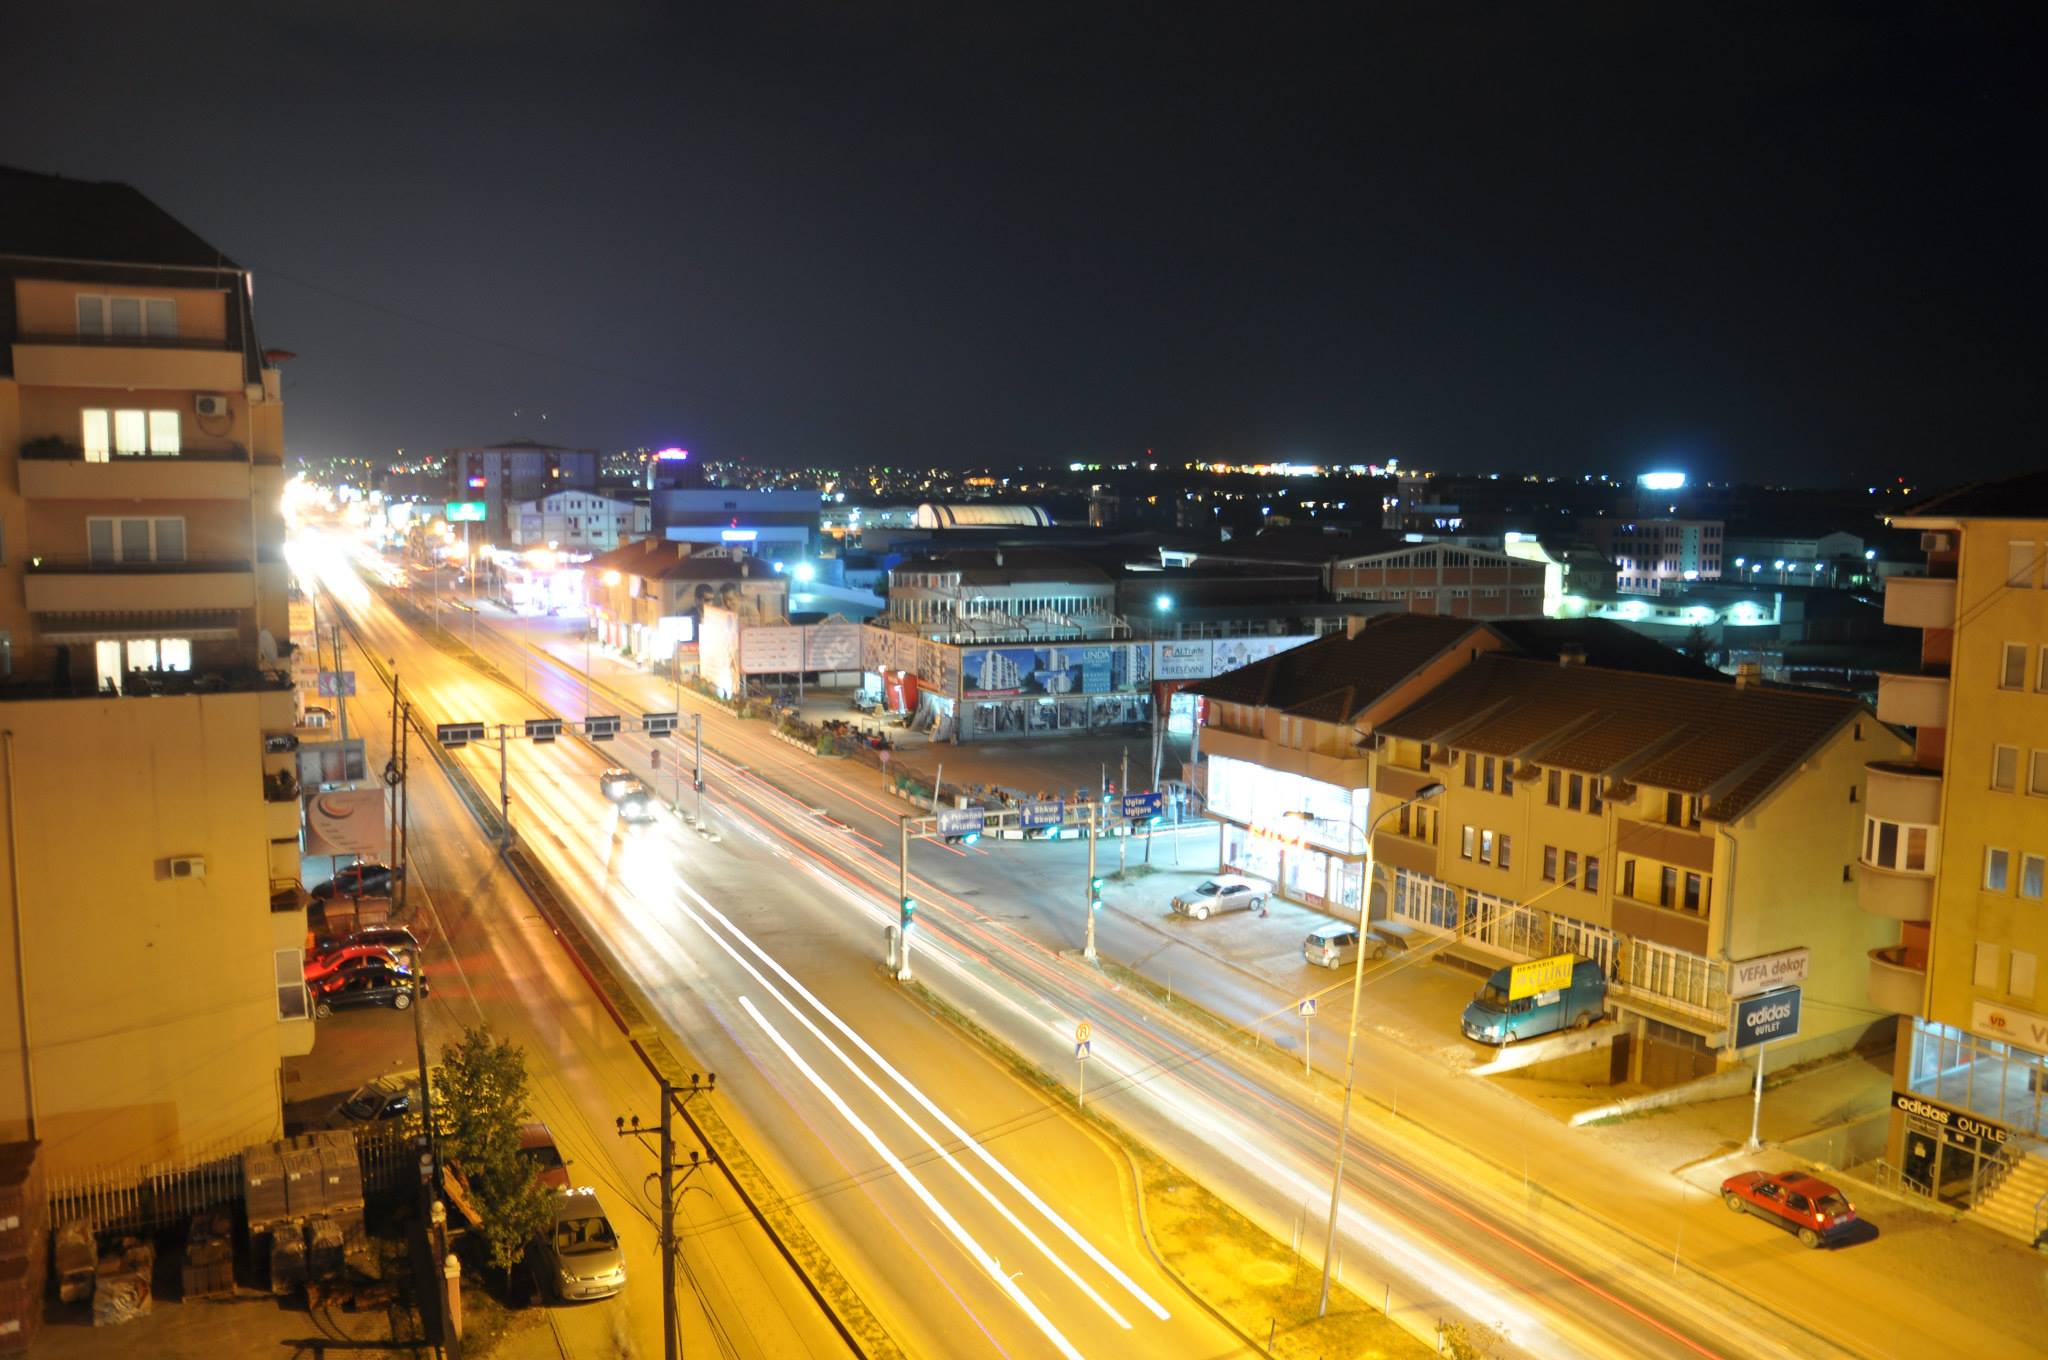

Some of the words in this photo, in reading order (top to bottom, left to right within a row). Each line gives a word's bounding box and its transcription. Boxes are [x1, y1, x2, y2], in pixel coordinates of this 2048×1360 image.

[1740, 965, 1767, 983] VEFA
[1772, 958, 1806, 975] dekor
[1747, 1004, 1790, 1027] adidas
[1755, 1022, 1780, 1036] OUTLET
[2031, 1023, 2048, 1046] V
[1898, 1098, 1948, 1124] adidas
[1958, 1118, 2008, 1144] OUTLE
